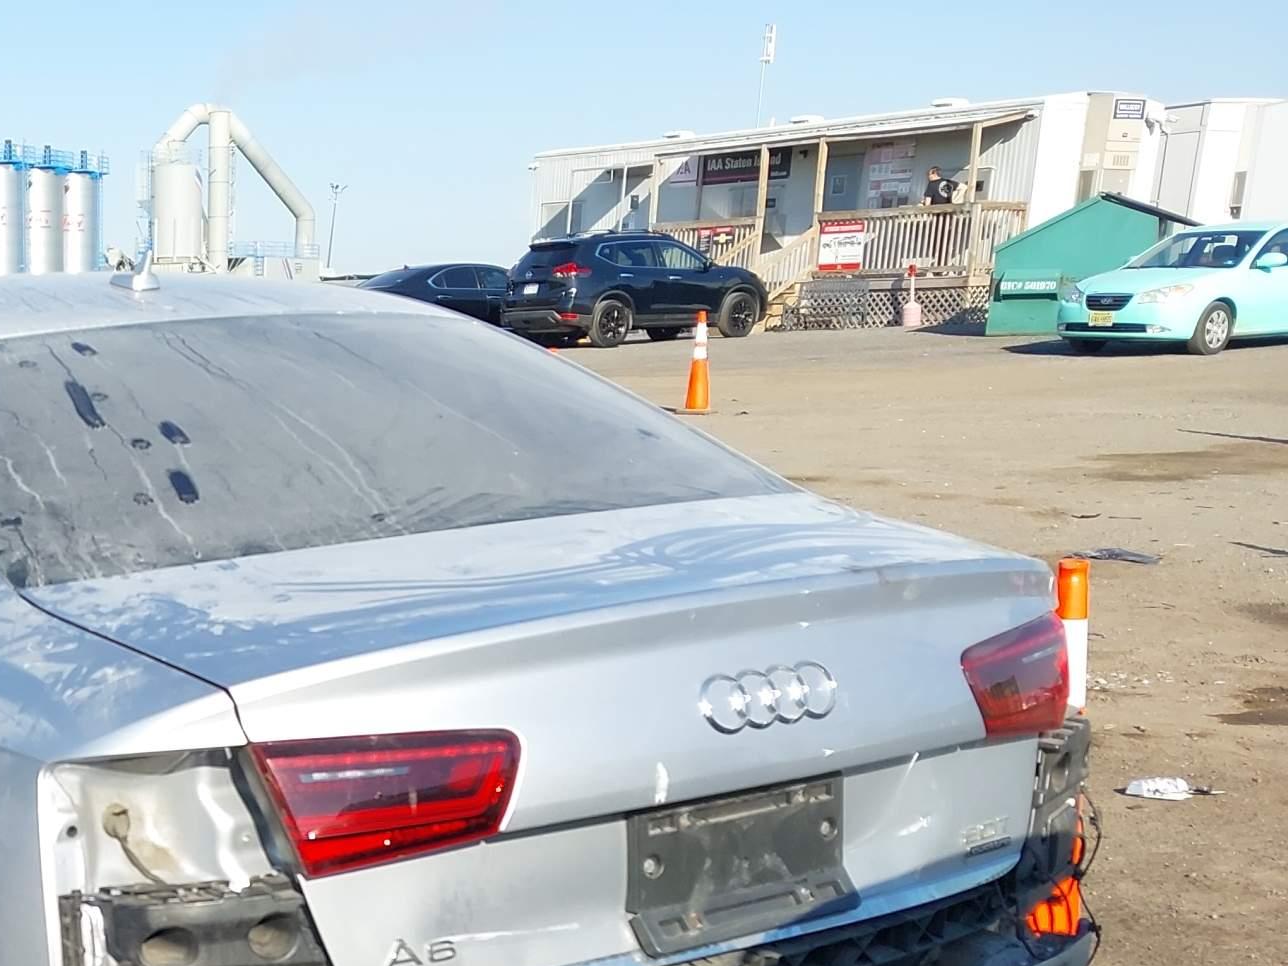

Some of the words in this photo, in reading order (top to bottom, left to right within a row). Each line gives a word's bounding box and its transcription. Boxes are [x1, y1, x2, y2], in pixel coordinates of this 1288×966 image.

[707, 159, 724, 172] IAA
[725, 157, 753, 170] Staten
[754, 152, 782, 167] Isnd
